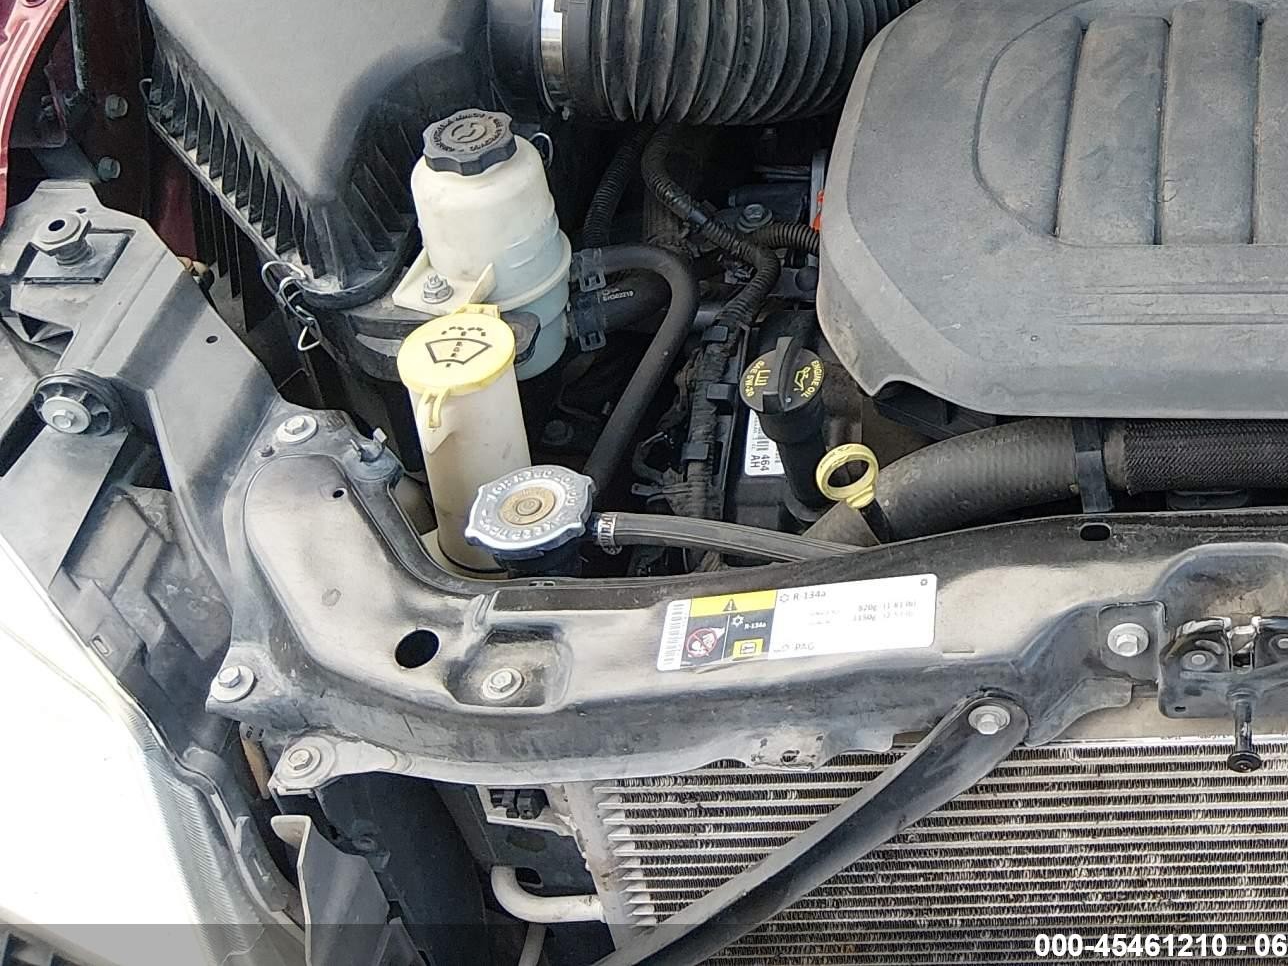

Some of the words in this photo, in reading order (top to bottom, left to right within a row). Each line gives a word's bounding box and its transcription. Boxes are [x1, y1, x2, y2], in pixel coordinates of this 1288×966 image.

[750, 360, 766, 374] SAE
[811, 360, 823, 387] ENGINE
[800, 386, 815, 398] OIL
[750, 455, 761, 468] AH
[760, 455, 770, 472] 464
[744, 621, 767, 631] R-134a
